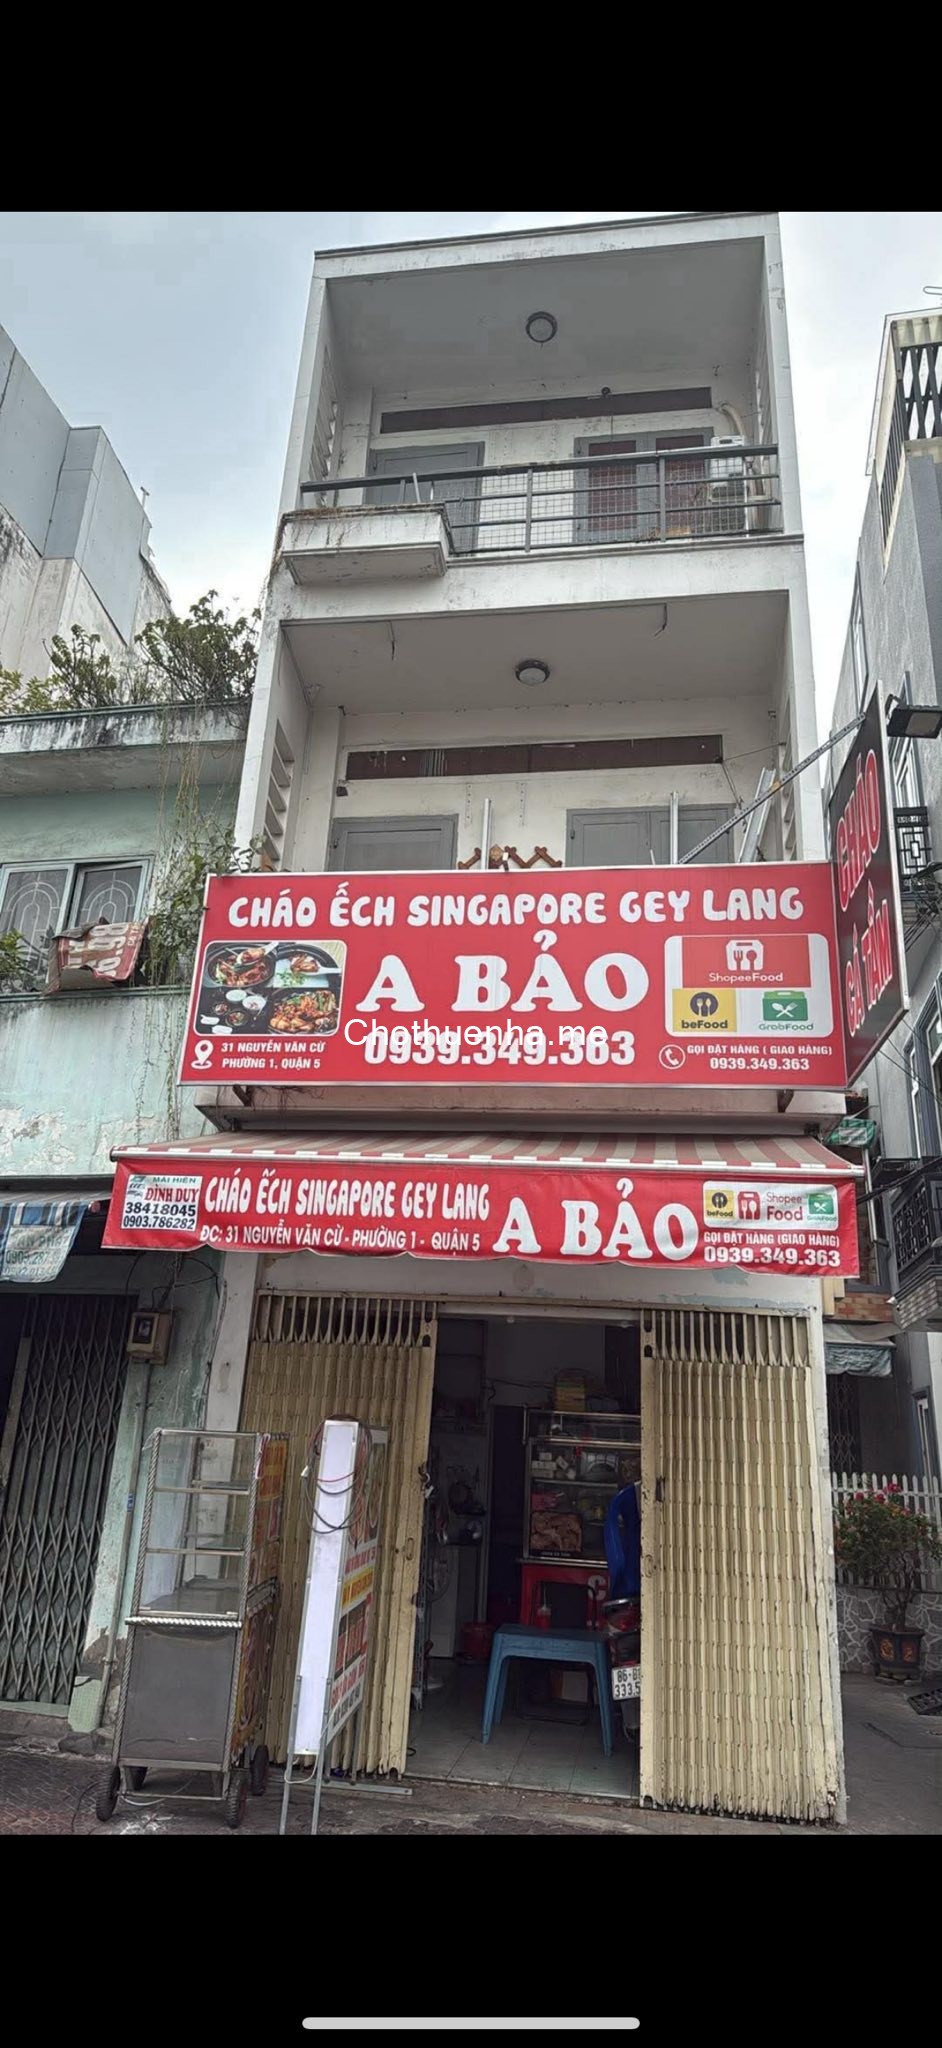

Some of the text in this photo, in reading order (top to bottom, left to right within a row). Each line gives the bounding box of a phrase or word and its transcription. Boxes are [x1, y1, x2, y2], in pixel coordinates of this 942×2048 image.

[835, 748, 881, 912] CHÁO
[228, 881, 804, 928] CHÁO ẾCH SINGAPORE GEY LANG
[356, 929, 650, 1012] A BẢO
[709, 973, 783, 984] ShopeeFood
[681, 1020, 728, 1029] beFood
[758, 1022, 814, 1031] GrabFood
[221, 1042, 234, 1052] 31
[364, 1030, 635, 1065] 0939.349.363
[687, 1045, 705, 1056] GỌI
[770, 1045, 795, 1054] GIAO
[281, 1056, 311, 1071] QUẬN
[314, 1058, 321, 1069] 5
[710, 1057, 810, 1070] 0939.349.363
[176, 1188, 199, 1203] DUY
[205, 1168, 490, 1220] CHÁO ẾCH SINGAPORE GEY LANG
[766, 1191, 803, 1205] Shopee
[125, 1202, 196, 1217] 38418045
[766, 1206, 803, 1221] Food
[123, 1215, 195, 1230] 0903.786282
[493, 1177, 699, 1261] A BẢO
[200, 1225, 222, 1243] ĐC:
[226, 1227, 238, 1243] 31
[243, 1218, 291, 1245] NGUYỄN
[295, 1226, 321, 1246] VĂN
[324, 1223, 344, 1246] CỪ
[352, 1225, 406, 1248] PHƯỜNG
[411, 1232, 416, 1248] 1
[431, 1228, 469, 1256] QUẬN
[472, 1233, 480, 1251] 5
[704, 1231, 720, 1246] GỌI
[746, 1231, 774, 1245] HÀNG
[704, 1246, 841, 1267] 0939.349.363
